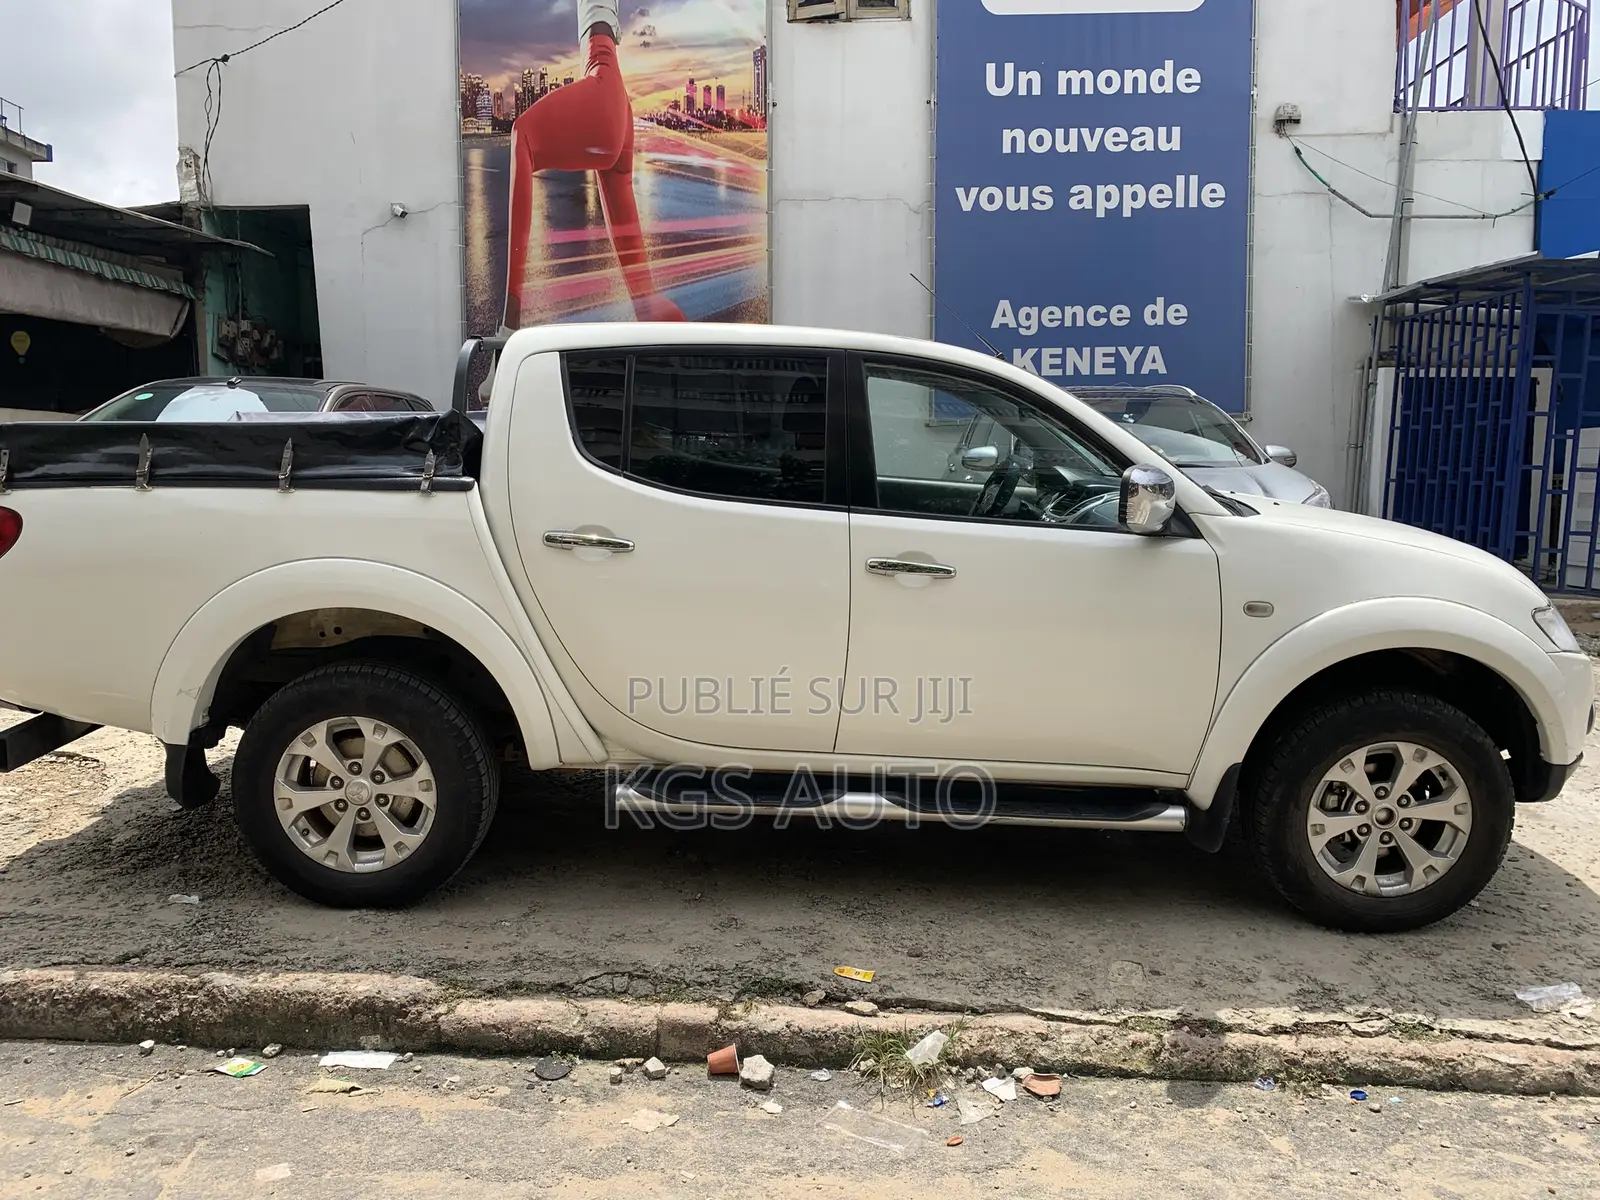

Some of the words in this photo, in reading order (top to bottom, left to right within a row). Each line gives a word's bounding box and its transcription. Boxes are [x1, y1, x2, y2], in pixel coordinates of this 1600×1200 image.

[985, 62, 1042, 96] Un
[1057, 59, 1202, 95] monde
[1002, 126, 1181, 154] nouveau
[955, 184, 1054, 212] vous
[1068, 174, 1226, 218] appelle
[990, 300, 1131, 336] Agence
[1143, 297, 1188, 326] de
[1011, 346, 1167, 376] KENEYA
